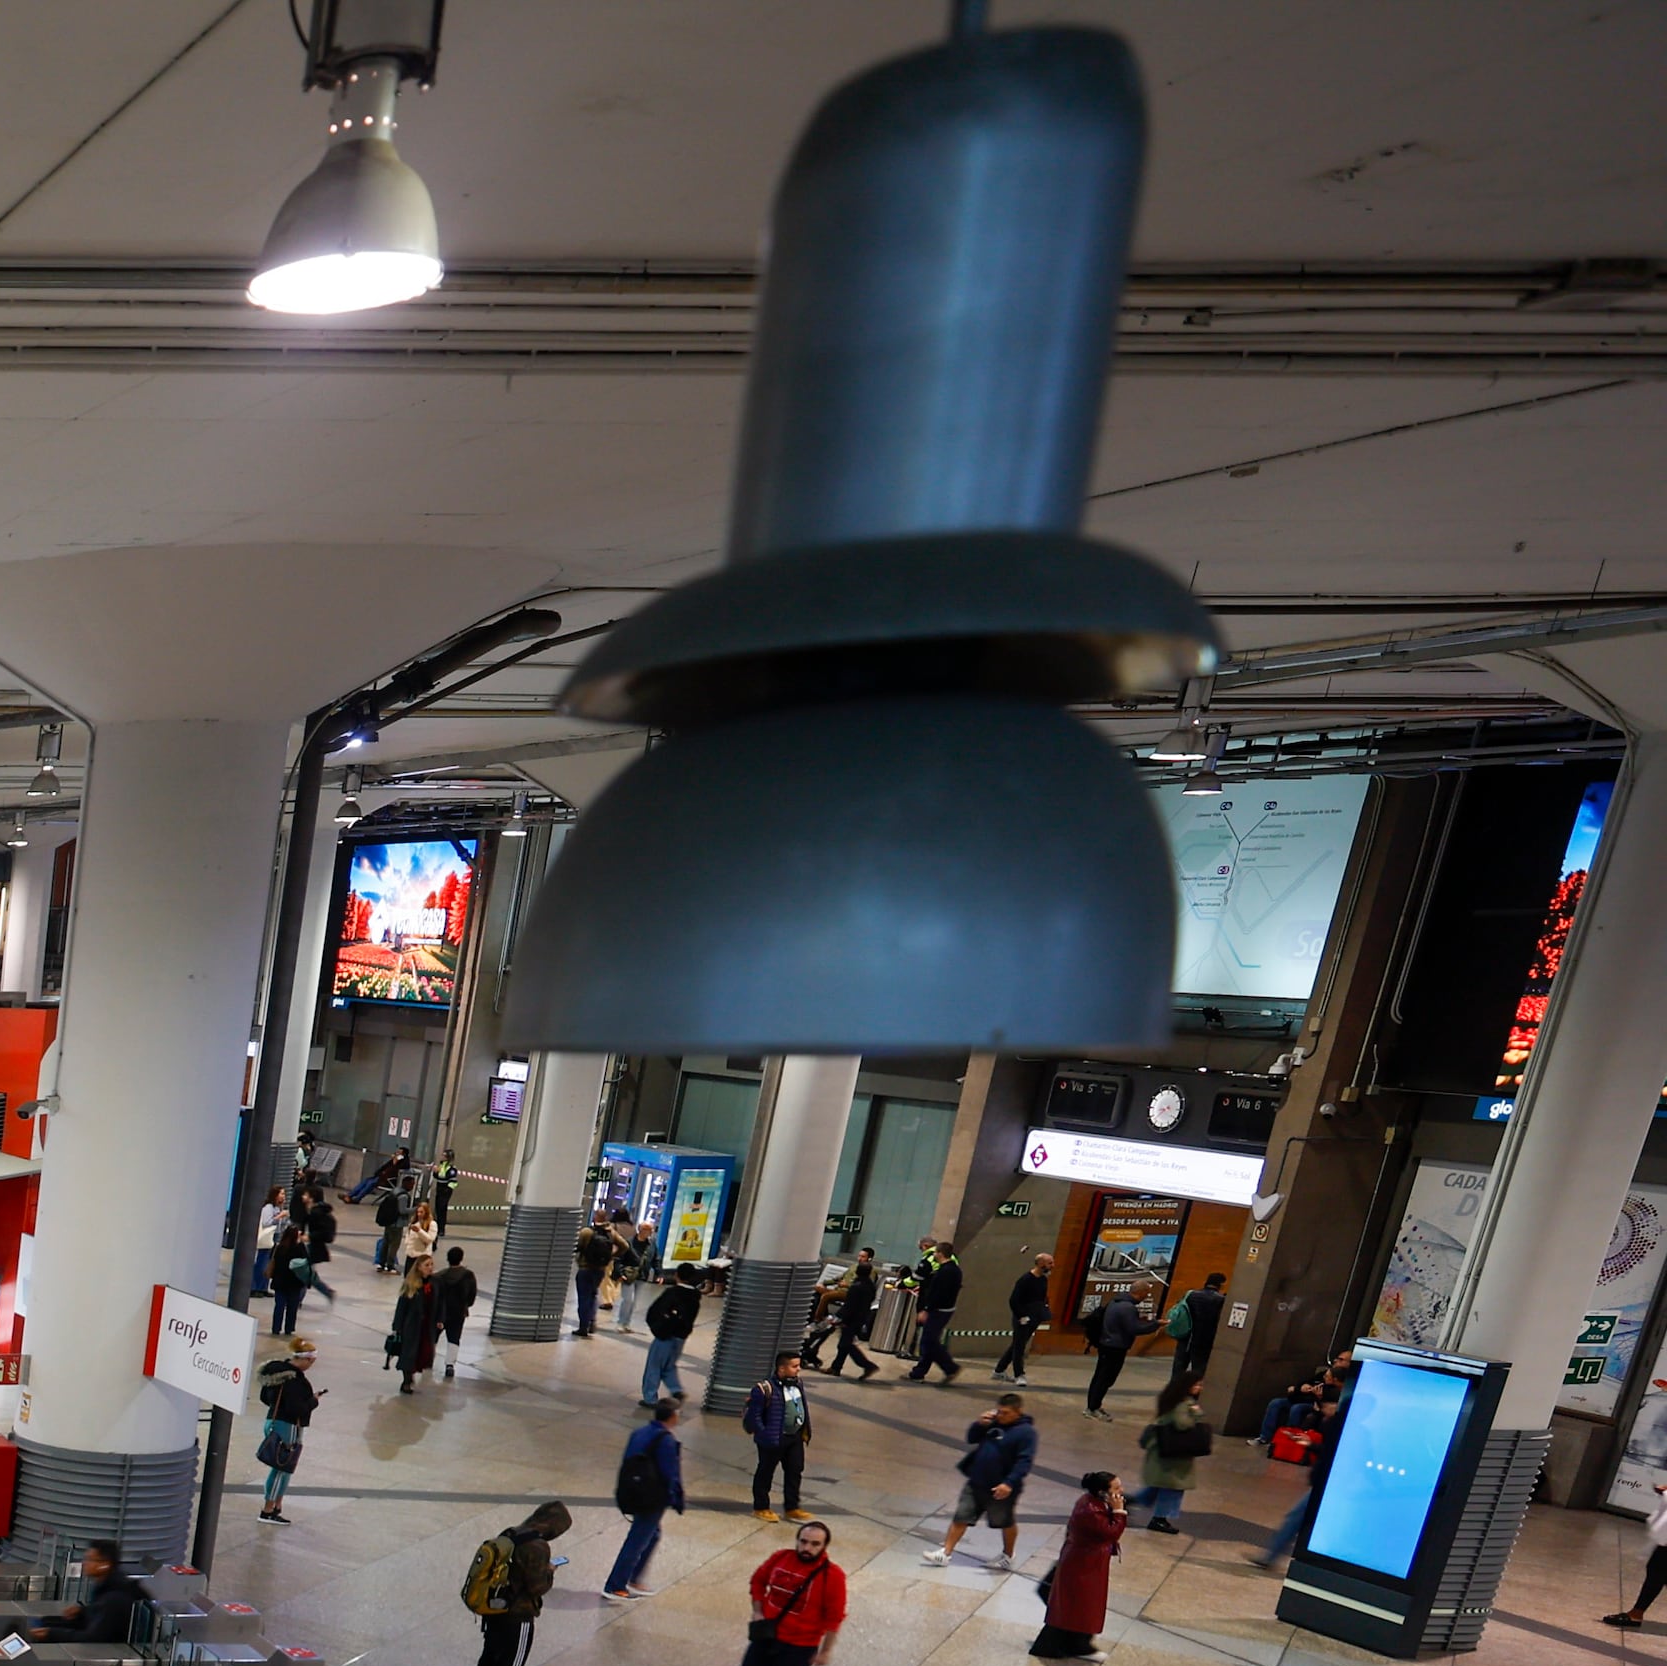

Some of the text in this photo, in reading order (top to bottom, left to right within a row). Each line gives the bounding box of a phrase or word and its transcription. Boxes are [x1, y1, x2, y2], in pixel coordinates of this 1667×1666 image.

[1088, 1084, 1094, 1093] 5
[1254, 1101, 1261, 1110] 6
[1034, 1147, 1044, 1164] 5
[1444, 1172, 1487, 1191] CADA
[1095, 1283, 1110, 1292] 911
[168, 1318, 208, 1348] renfe
[1616, 1478, 1643, 1489] renfe
